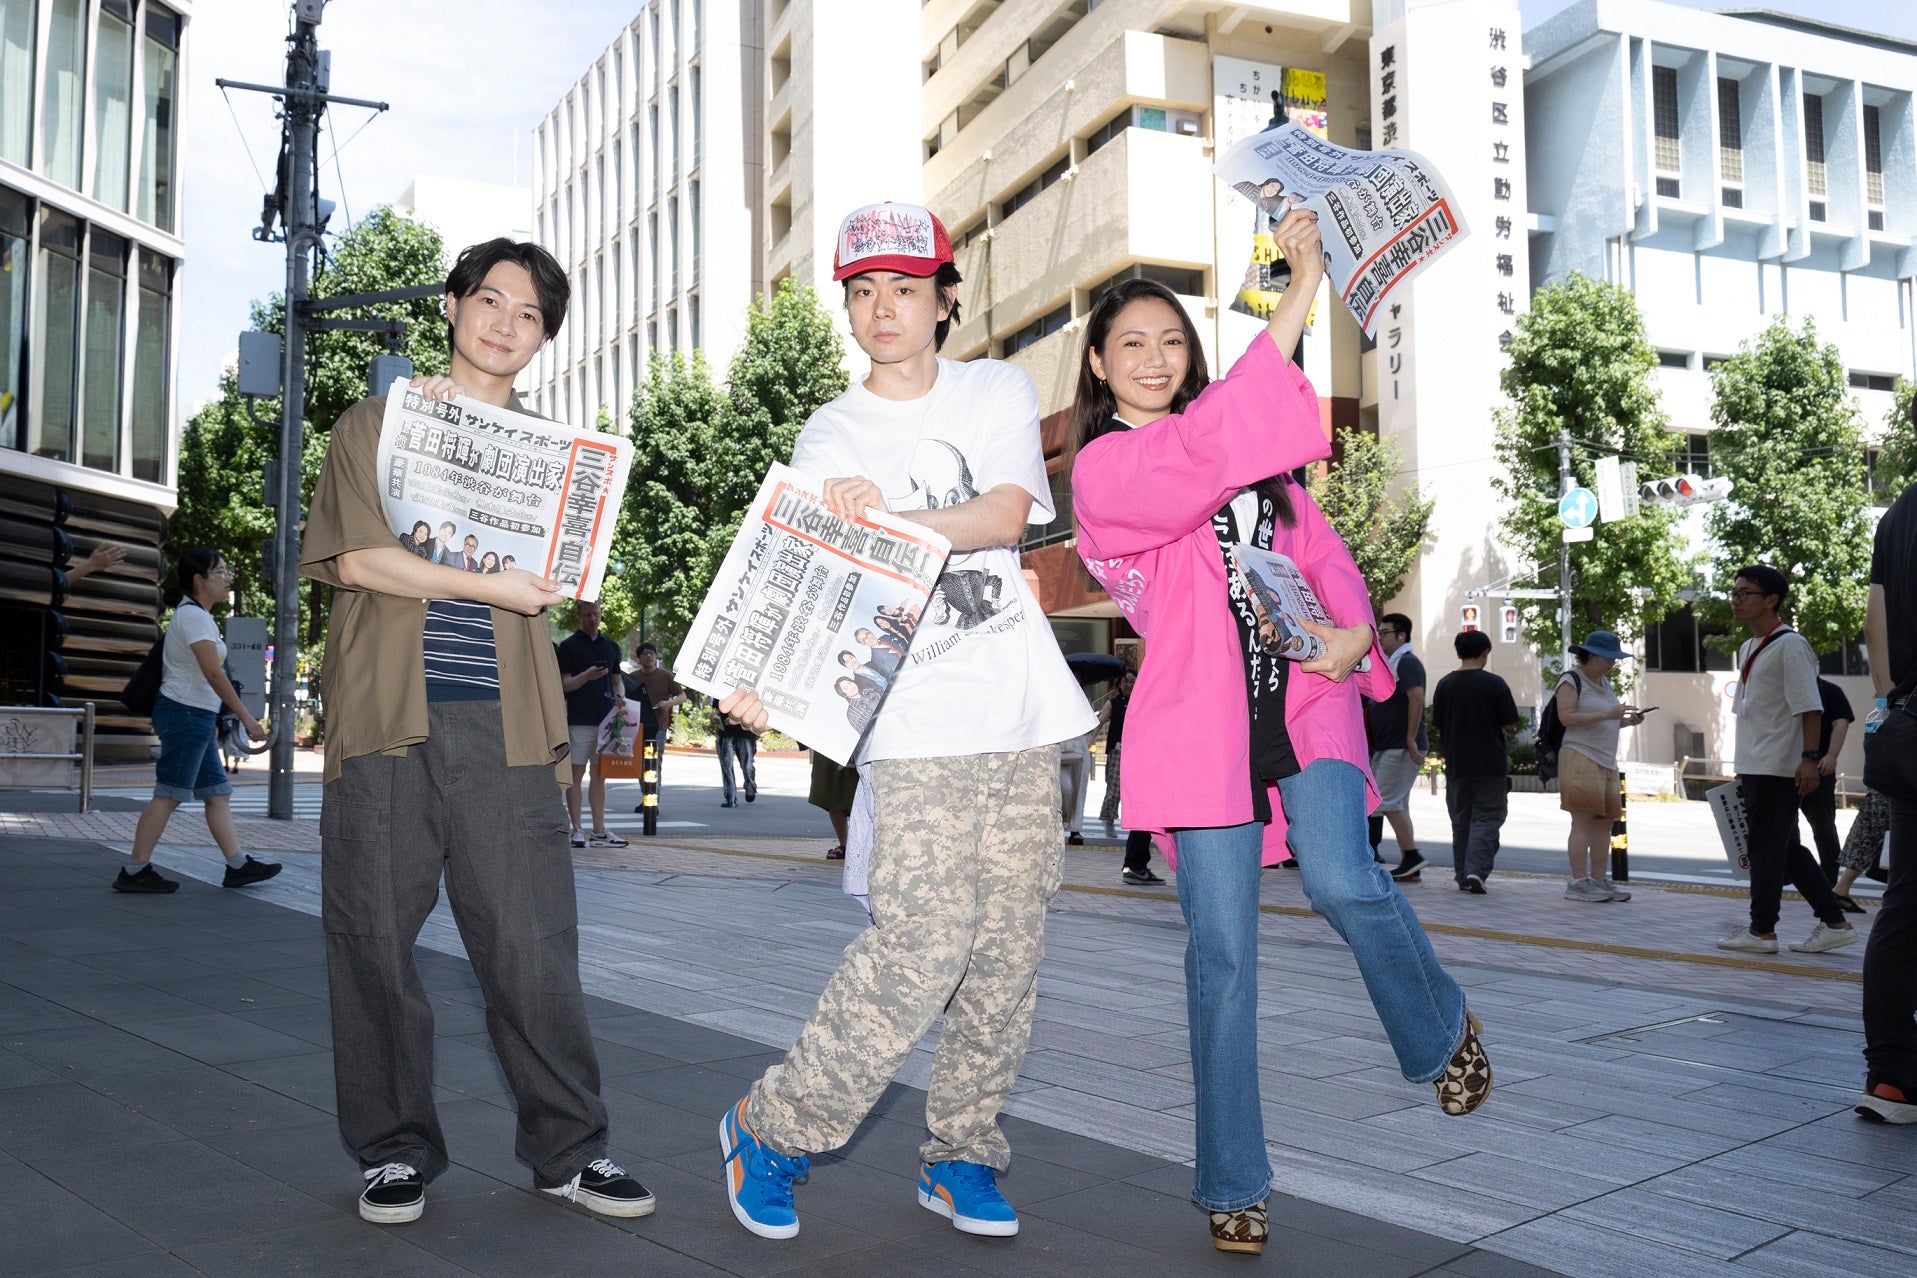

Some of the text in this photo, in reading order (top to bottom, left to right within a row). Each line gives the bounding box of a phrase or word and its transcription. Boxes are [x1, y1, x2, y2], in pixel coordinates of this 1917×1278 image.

[403, 392, 462, 425] 特別号外
[465, 412, 572, 452] サンケイスポーツ
[413, 461, 543, 507] 1984年渋谷が舞台
[469, 510, 543, 536] 三谷作品初参加
[725, 522, 777, 617] サンケイスポーツ
[769, 565, 830, 682] 1984年渋谷が舞台
[693, 617, 734, 679] 特別号外
[910, 631, 963, 666] William
